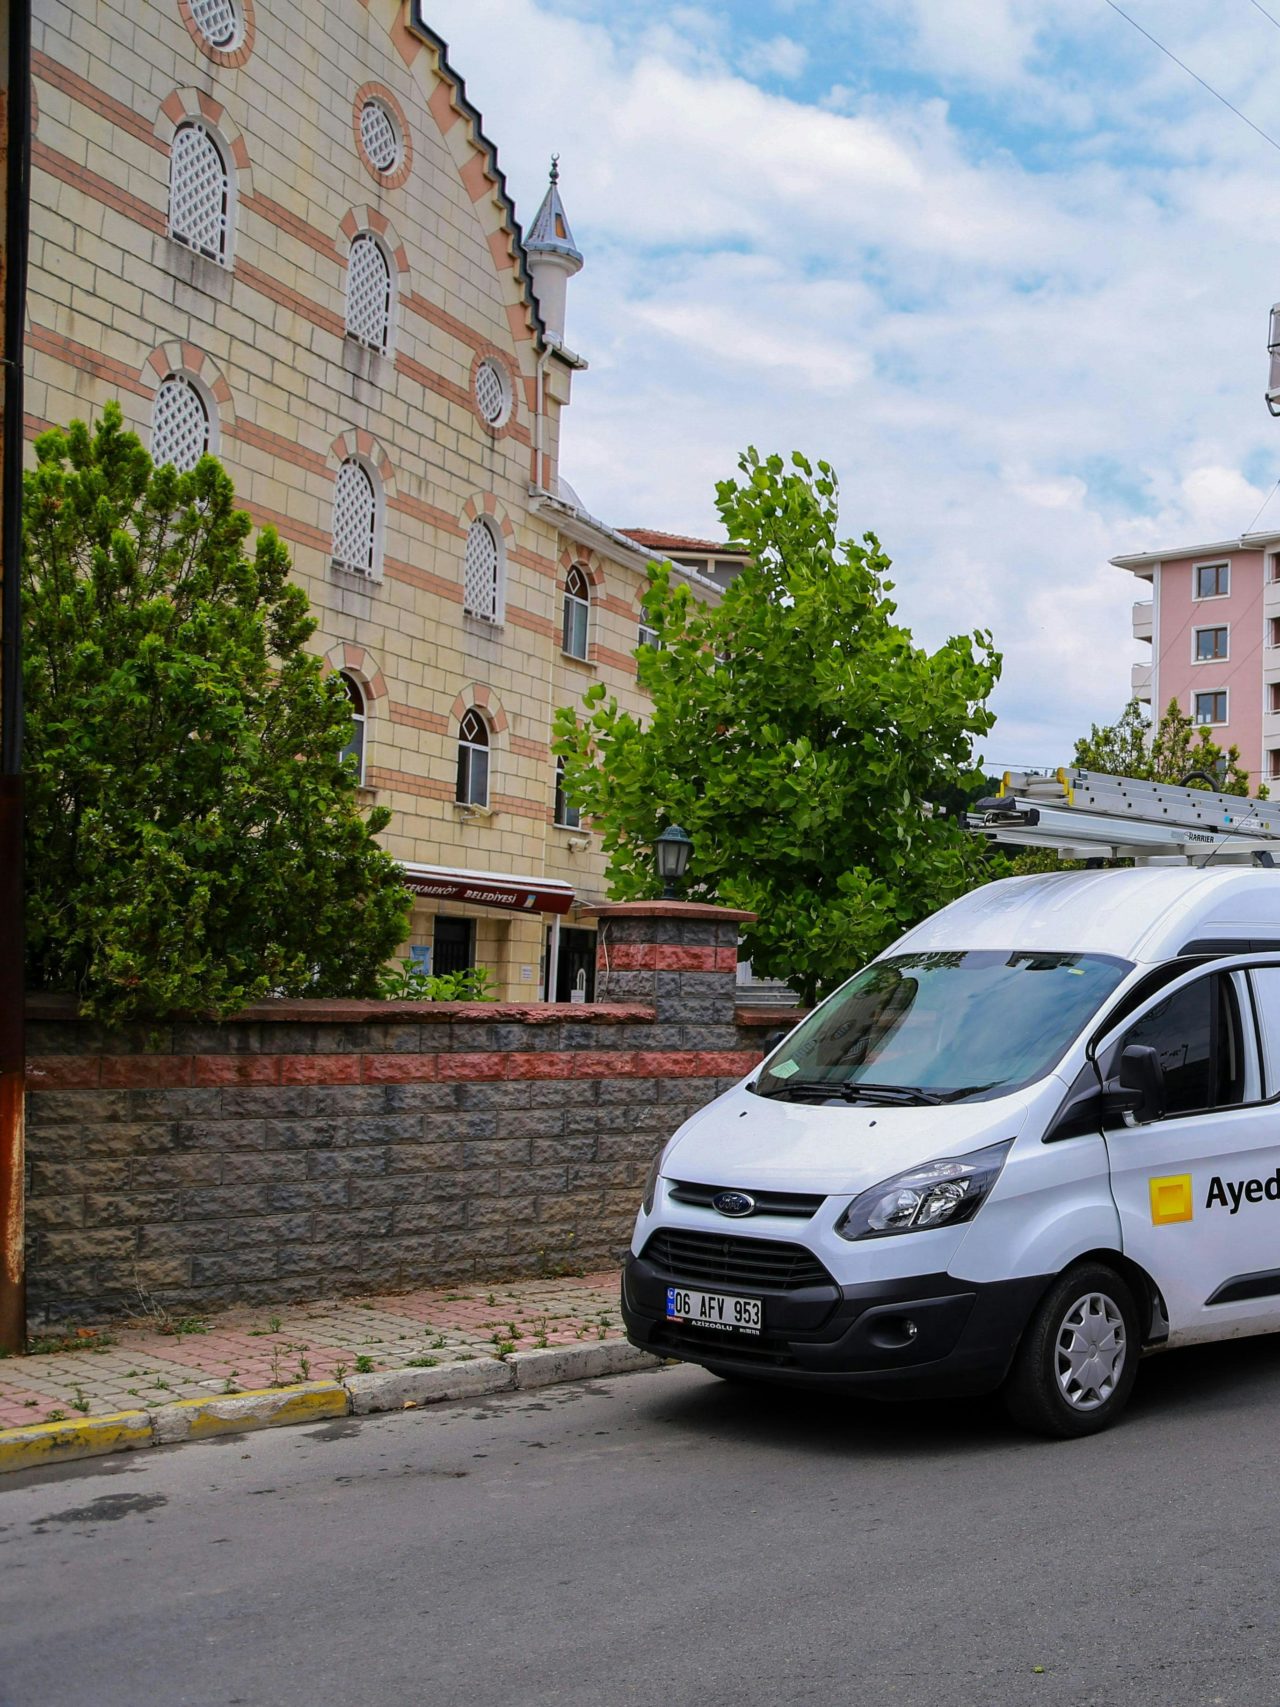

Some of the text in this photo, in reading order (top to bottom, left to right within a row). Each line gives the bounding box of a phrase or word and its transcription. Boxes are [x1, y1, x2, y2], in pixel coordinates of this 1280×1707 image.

[464, 890, 517, 903] BELEDİYESİ
[675, 1291, 760, 1326] 06 AFV 953
[691, 1320, 733, 1331] AZİZOĞLU
